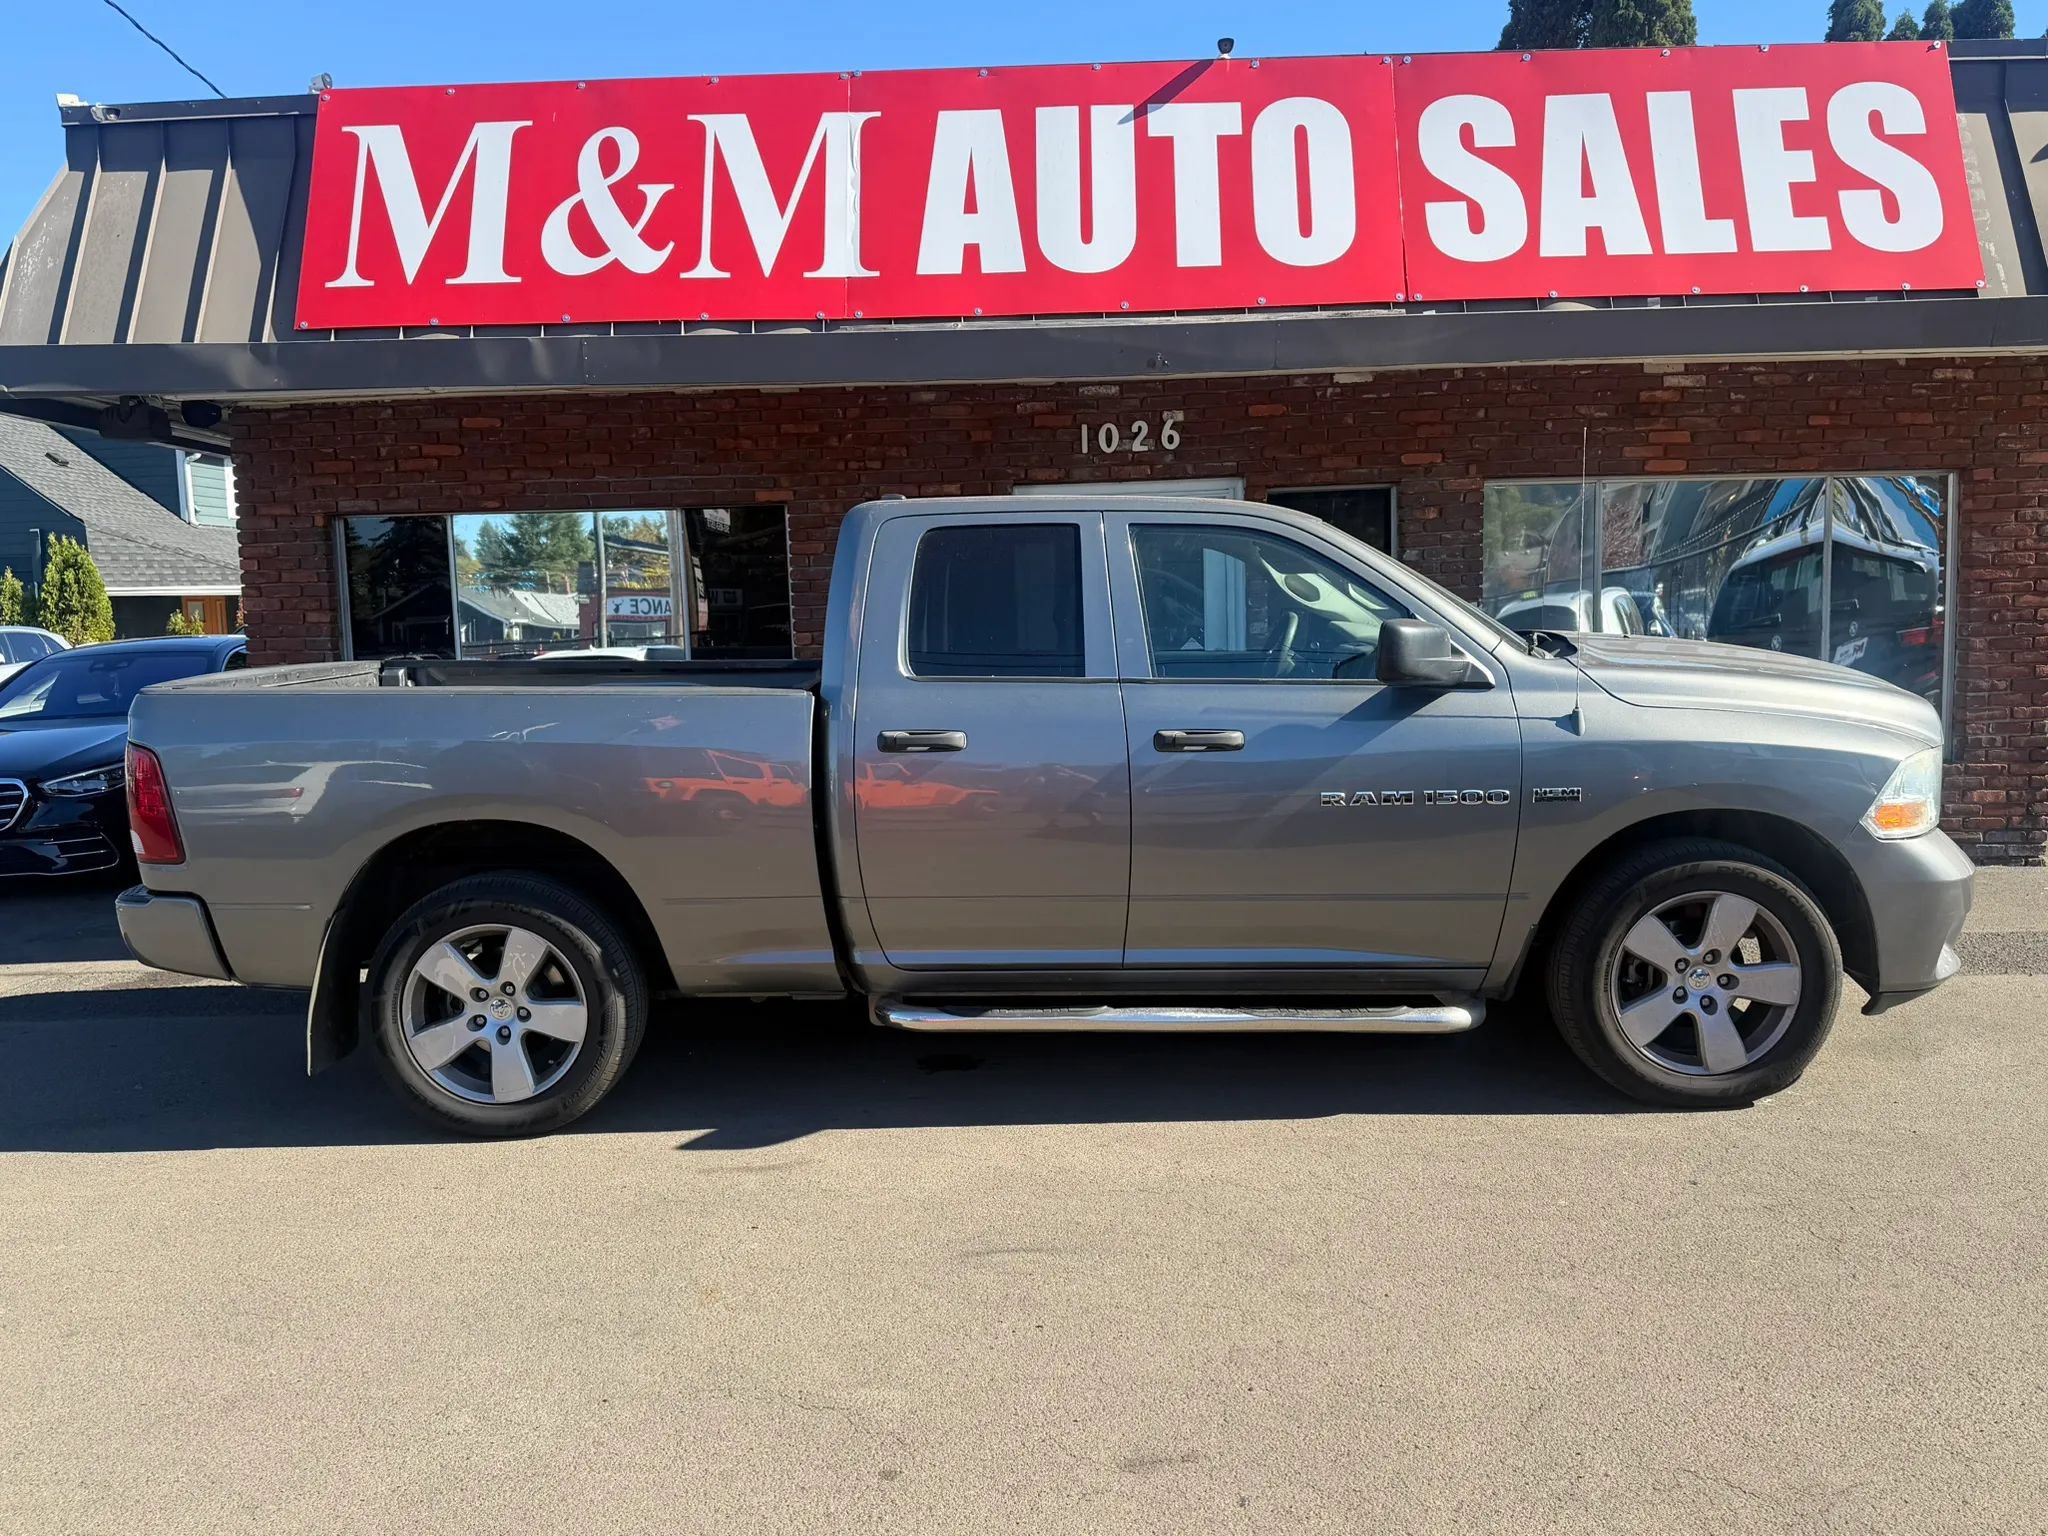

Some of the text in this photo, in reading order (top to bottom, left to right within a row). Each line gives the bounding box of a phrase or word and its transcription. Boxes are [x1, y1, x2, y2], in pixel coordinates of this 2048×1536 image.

[325, 82, 1945, 286] M&M AUTO SALES
[1081, 419, 1180, 454] 1026
[1320, 789, 1511, 807] RAM 1500
